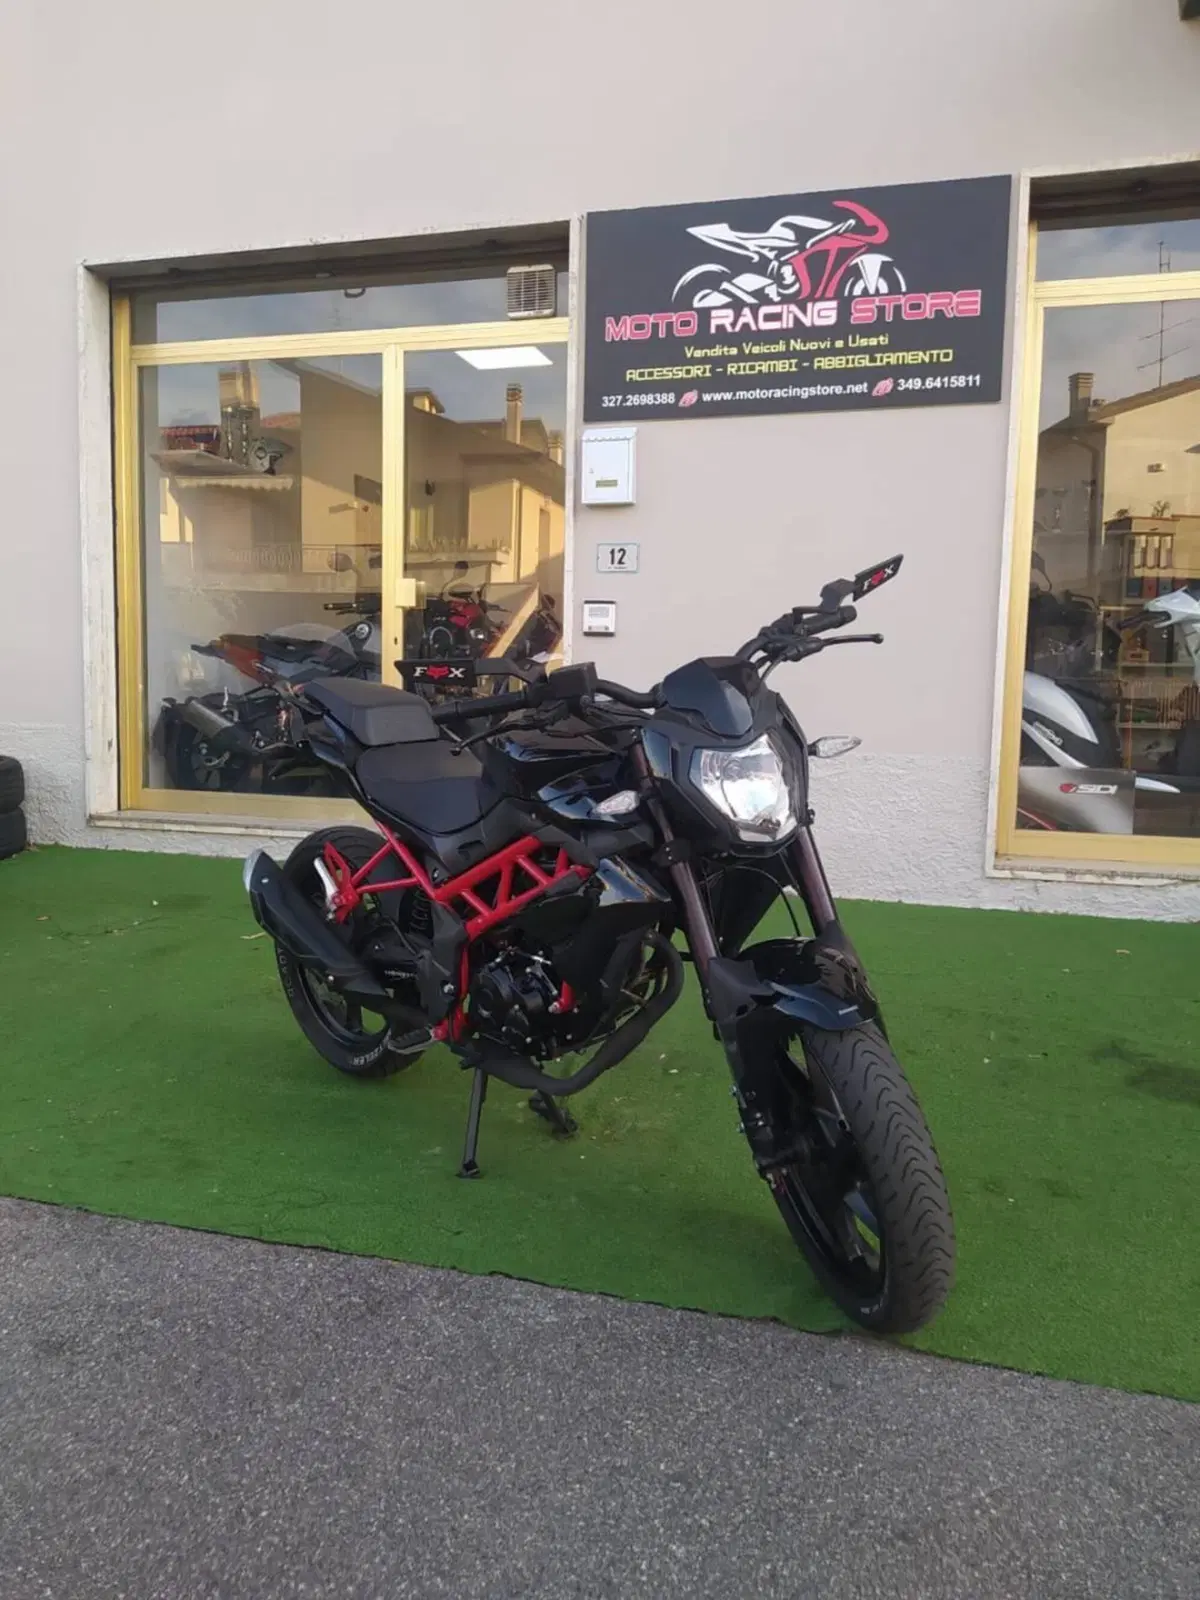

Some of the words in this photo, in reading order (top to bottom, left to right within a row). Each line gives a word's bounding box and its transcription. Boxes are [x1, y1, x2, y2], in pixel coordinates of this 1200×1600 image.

[605, 311, 698, 342] MOTO
[710, 300, 838, 334] RACING
[850, 289, 982, 324] STORE
[684, 344, 738, 358] Vendita
[742, 339, 786, 355] Veicoli
[789, 336, 831, 351] Nuovi
[834, 338, 844, 348] e
[848, 333, 889, 347] Usati
[626, 364, 712, 382] ACCESSORI
[727, 358, 798, 375] RICAMBI
[814, 349, 953, 370] ABBIGLIAMENTO
[602, 392, 676, 408] 327.2698388
[702, 381, 868, 403] www.motoracingstore.net
[897, 374, 981, 391] 349.6415811
[610, 547, 627, 565] 12
